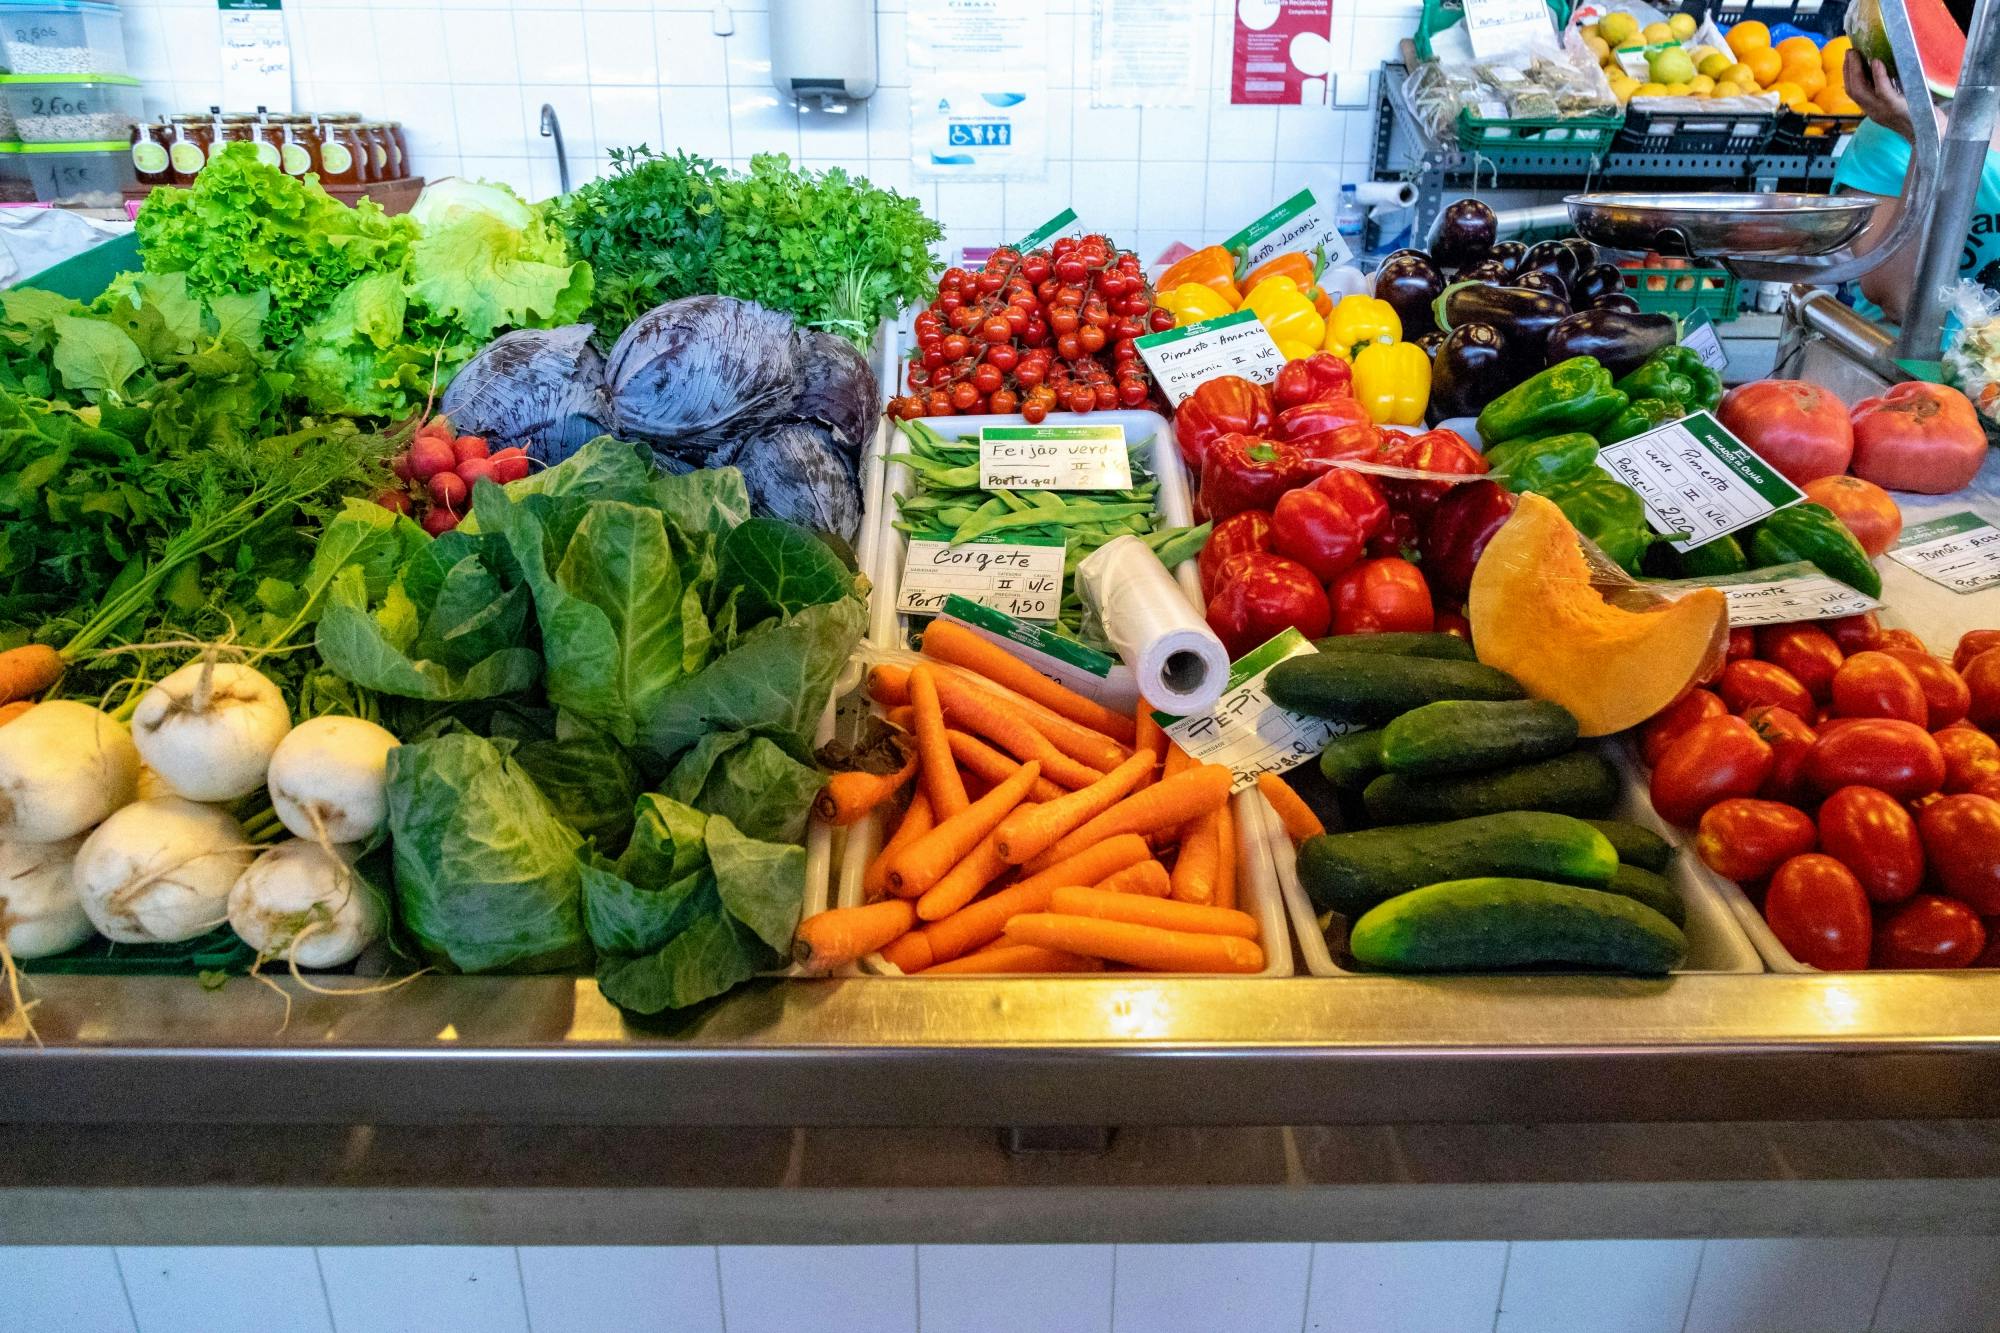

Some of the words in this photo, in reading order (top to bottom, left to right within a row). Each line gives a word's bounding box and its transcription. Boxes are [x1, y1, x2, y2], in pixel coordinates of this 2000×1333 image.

[1160, 341, 1208, 363] Pimento
[1220, 328, 1265, 345] Amarelo
[992, 444, 1058, 459] Feijão
[1704, 434, 1737, 461] MERCADOS
[1741, 465, 1764, 484] OLHÃO
[1616, 457, 1655, 493] Portugal
[1680, 449, 1729, 492] Pimento
[988, 475, 1057, 487] Portugal
[1683, 488, 1700, 502] II
[933, 549, 1031, 571] Corgete
[997, 579, 1014, 589] II
[1028, 578, 1054, 593] N/C
[1009, 600, 1045, 615] 1,50
